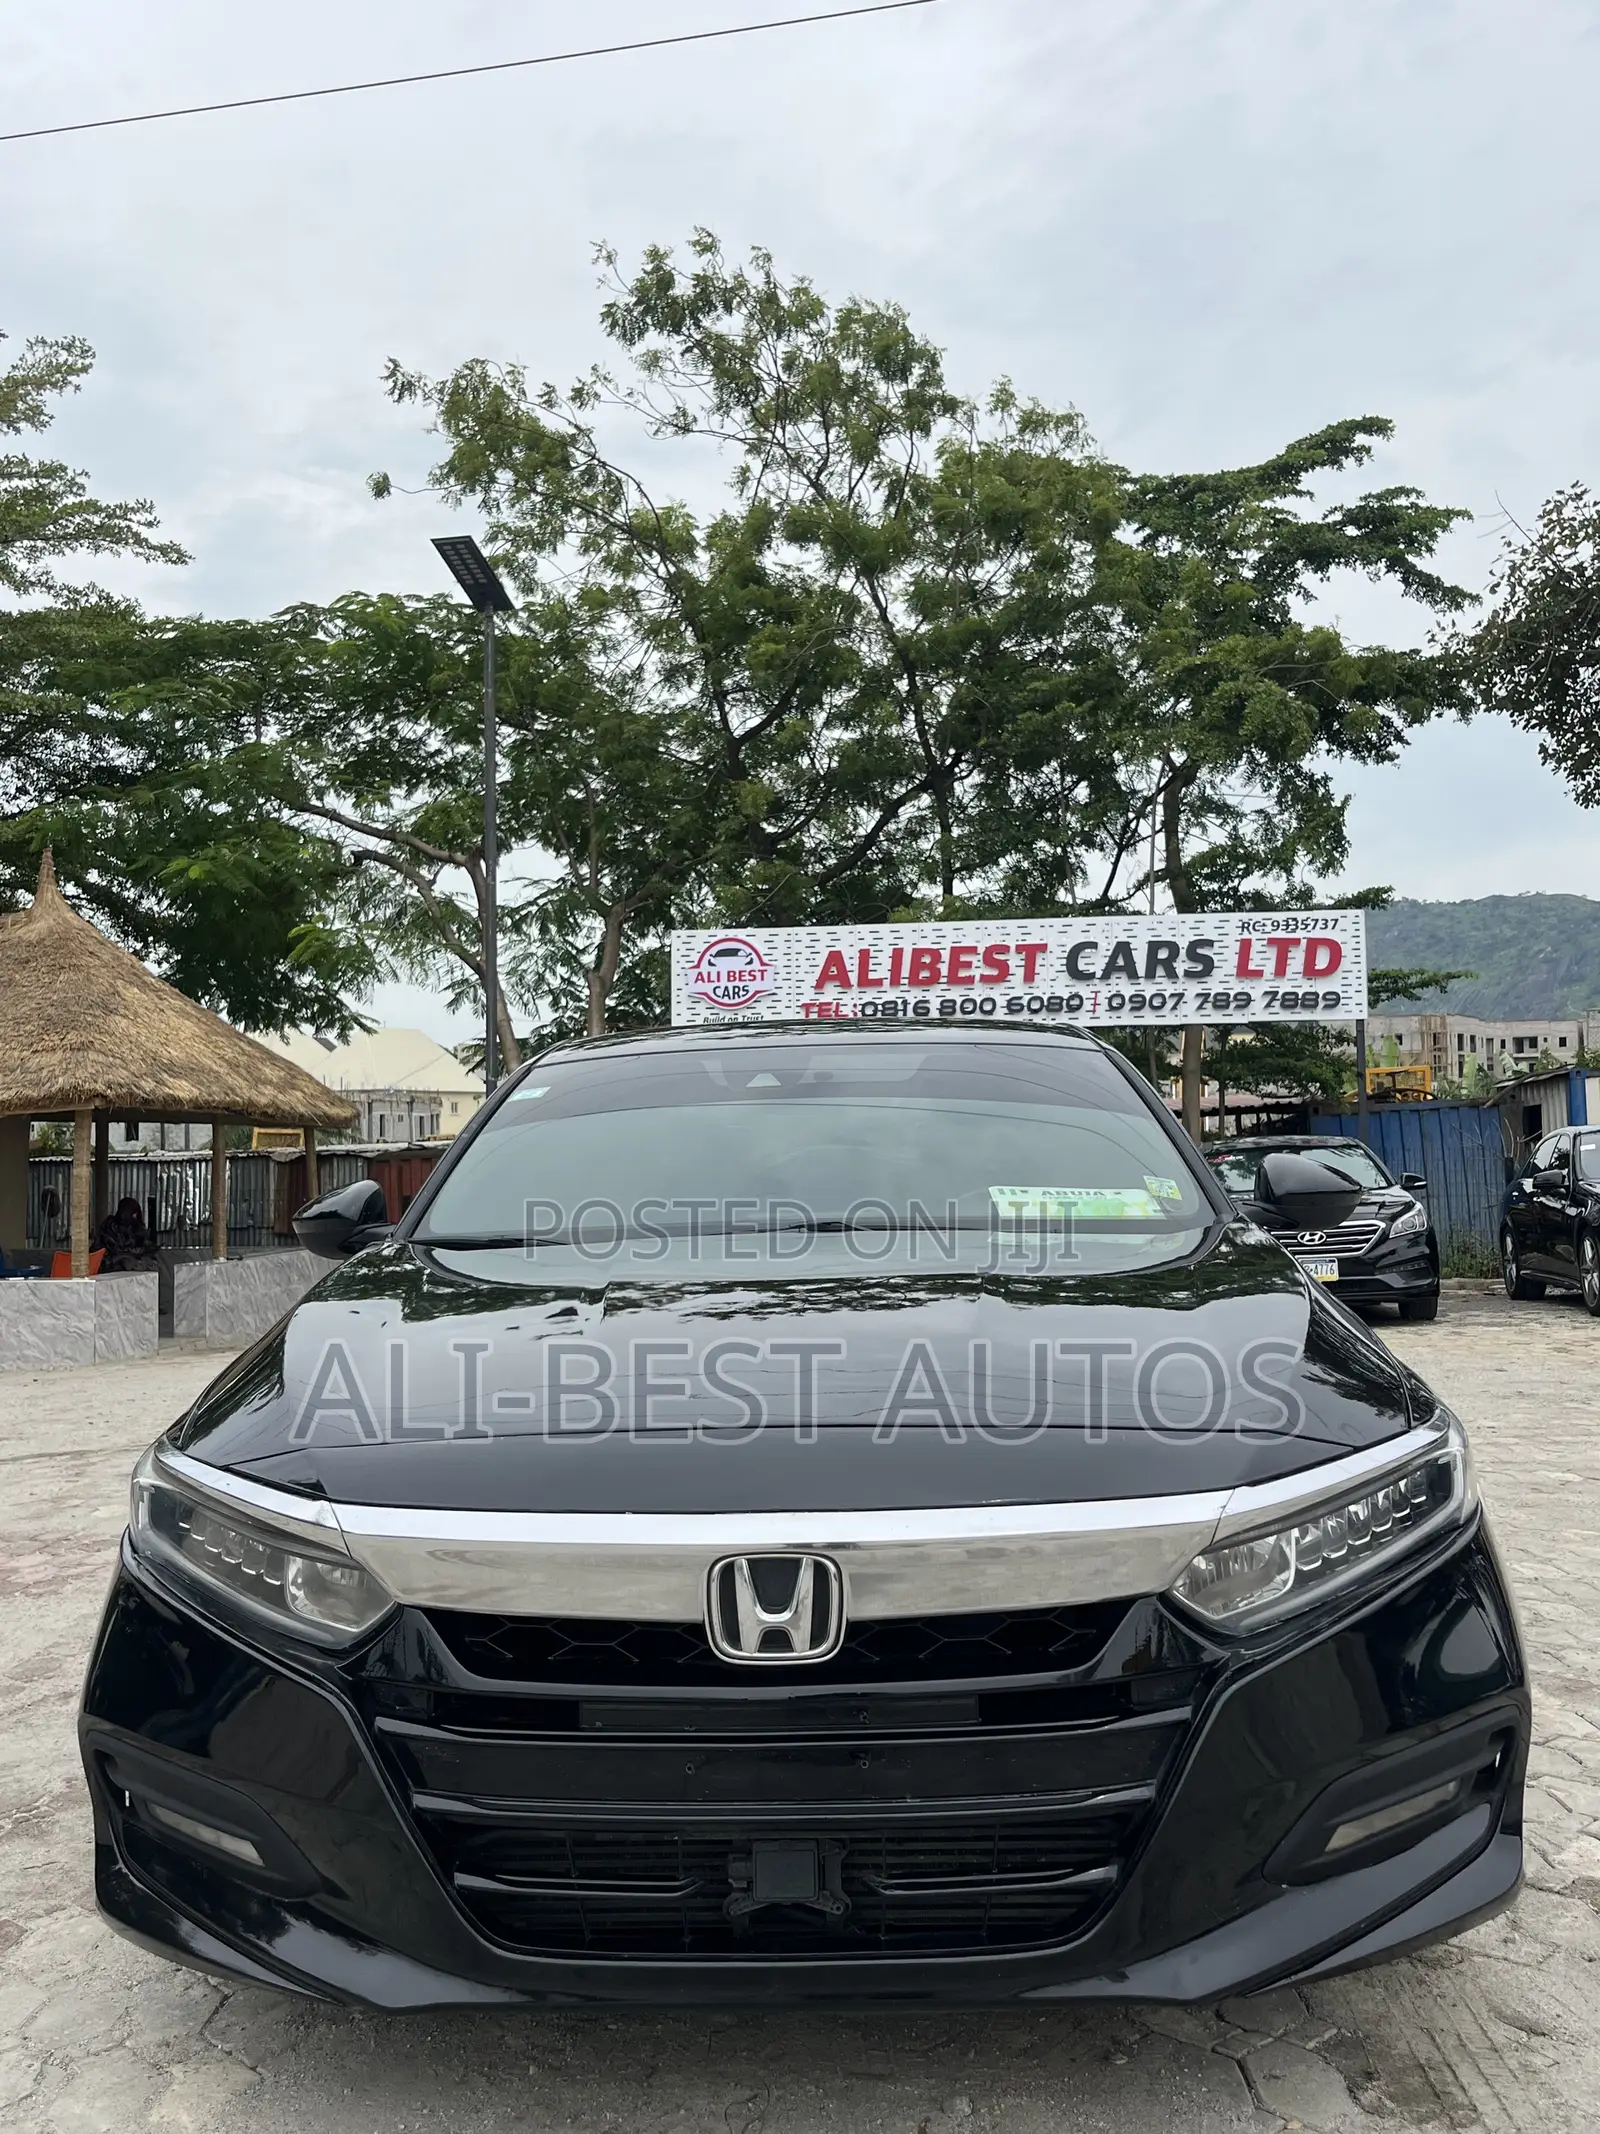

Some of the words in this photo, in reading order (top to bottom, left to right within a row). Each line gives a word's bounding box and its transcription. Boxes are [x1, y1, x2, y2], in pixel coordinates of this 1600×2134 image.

[814, 943, 1048, 990] ALIBEST
[1065, 938, 1215, 981] CARS
[1235, 937, 1343, 979] LTD
[694, 970, 721, 984] ALI
[726, 969, 768, 983] BEST
[712, 984, 750, 1000] CARS
[939, 997, 997, 1016] 800
[1006, 994, 1084, 1014] 6080
[1107, 993, 1186, 1012] 0907
[1195, 991, 1251, 1011] 789
[1261, 990, 1342, 1010] 7889
